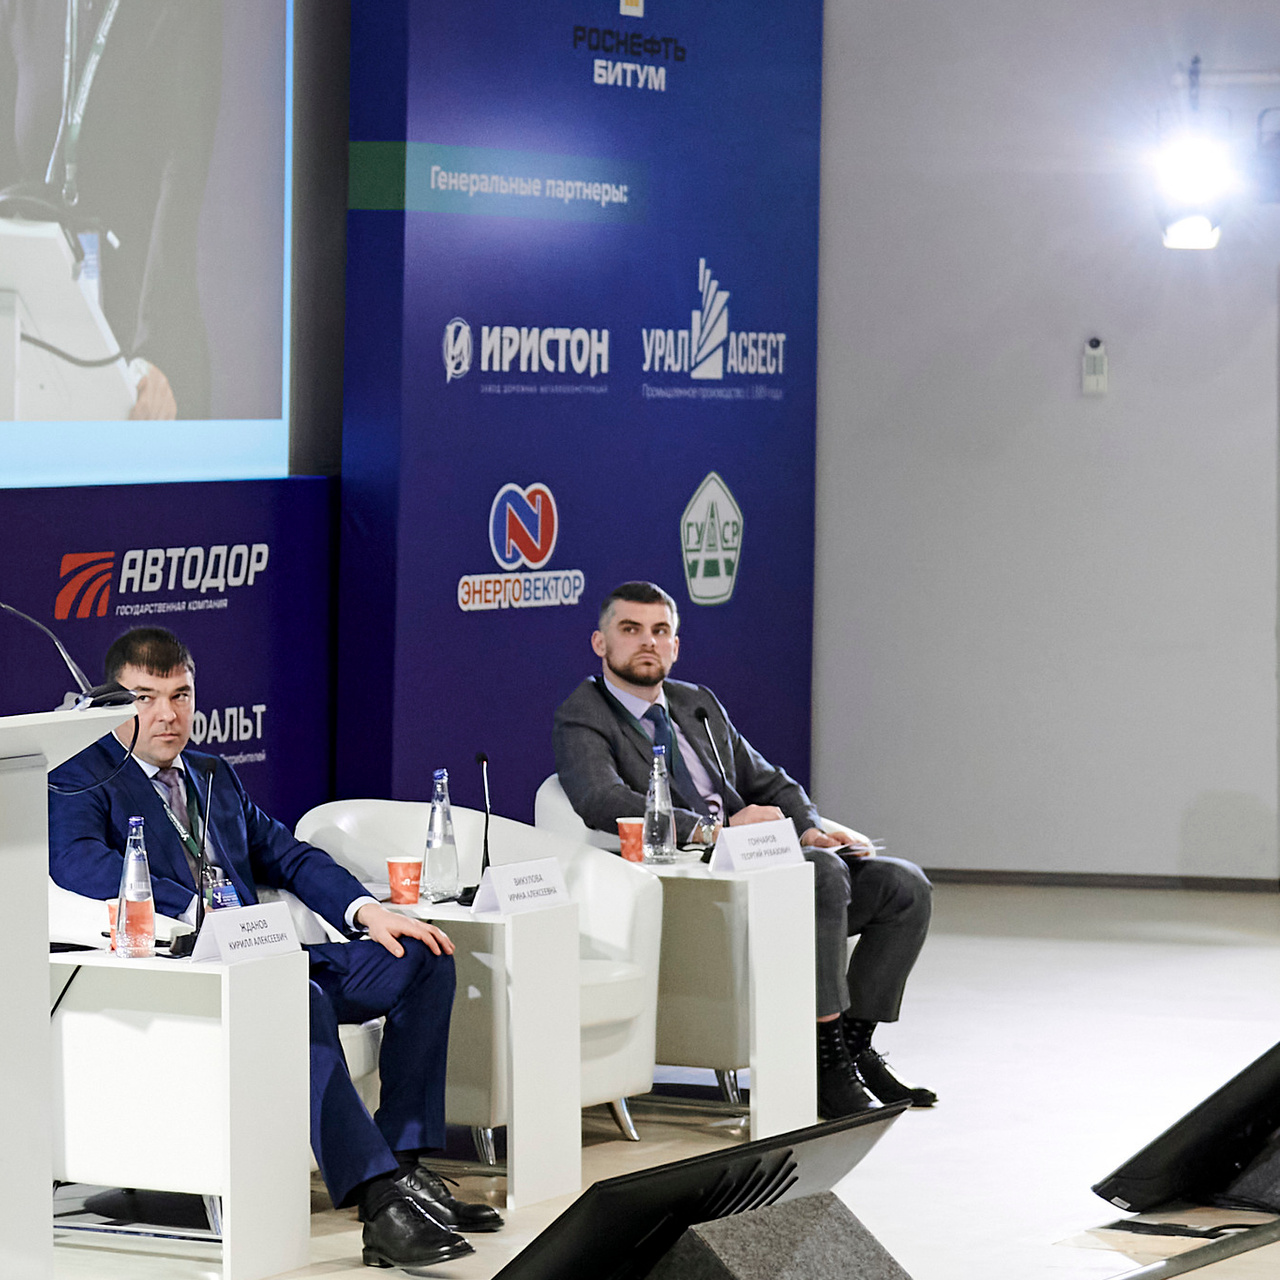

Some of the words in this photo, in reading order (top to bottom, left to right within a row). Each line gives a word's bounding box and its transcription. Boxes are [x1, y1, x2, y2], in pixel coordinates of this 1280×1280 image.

[573, 26, 687, 62] РОСНЕФТЬ
[594, 59, 666, 92] БИТУМ
[430, 164, 542, 198] Генеральные
[545, 176, 629, 207] партнеры:
[480, 325, 609, 378] ИРИСТОН
[119, 543, 269, 593] АВТОДОР
[459, 573, 583, 606] ЭНЕРГОВЕКТОР
[115, 600, 186, 616] ГОСУДАРСТВЕННАЯ
[187, 598, 228, 611] КОМПАНИЯ
[190, 704, 266, 745] ФАЛЬТ
[228, 938, 253, 950] КИРИЛЛ
[254, 932, 288, 946] АЛЕКСЕЕВИЧ
[239, 919, 269, 933] ЖДАНОВ
